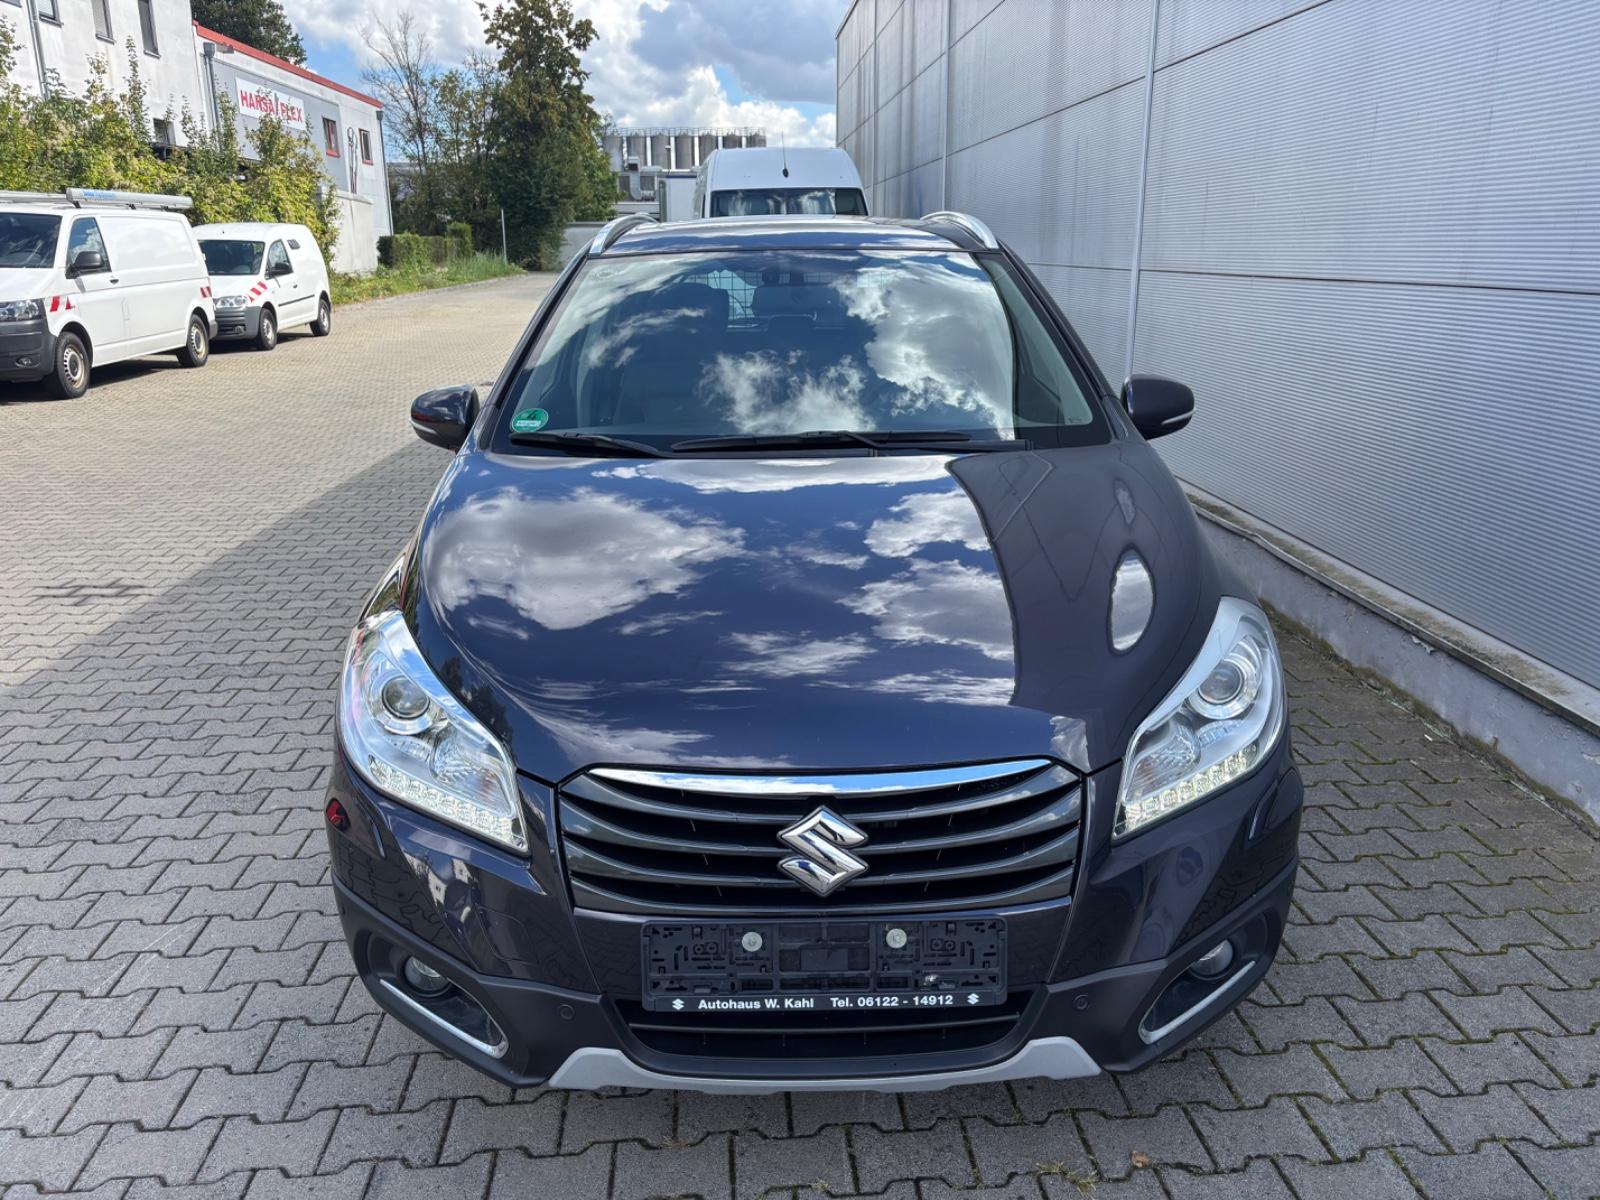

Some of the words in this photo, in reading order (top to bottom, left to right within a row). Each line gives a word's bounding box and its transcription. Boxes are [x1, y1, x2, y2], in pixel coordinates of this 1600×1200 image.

[698, 999, 761, 1010] Autohaus
[764, 998, 780, 1009] W.
[784, 997, 815, 1008] Kahl
[830, 997, 853, 1008] Tel.
[857, 996, 900, 1007] 06122
[912, 995, 954, 1006] 14912
